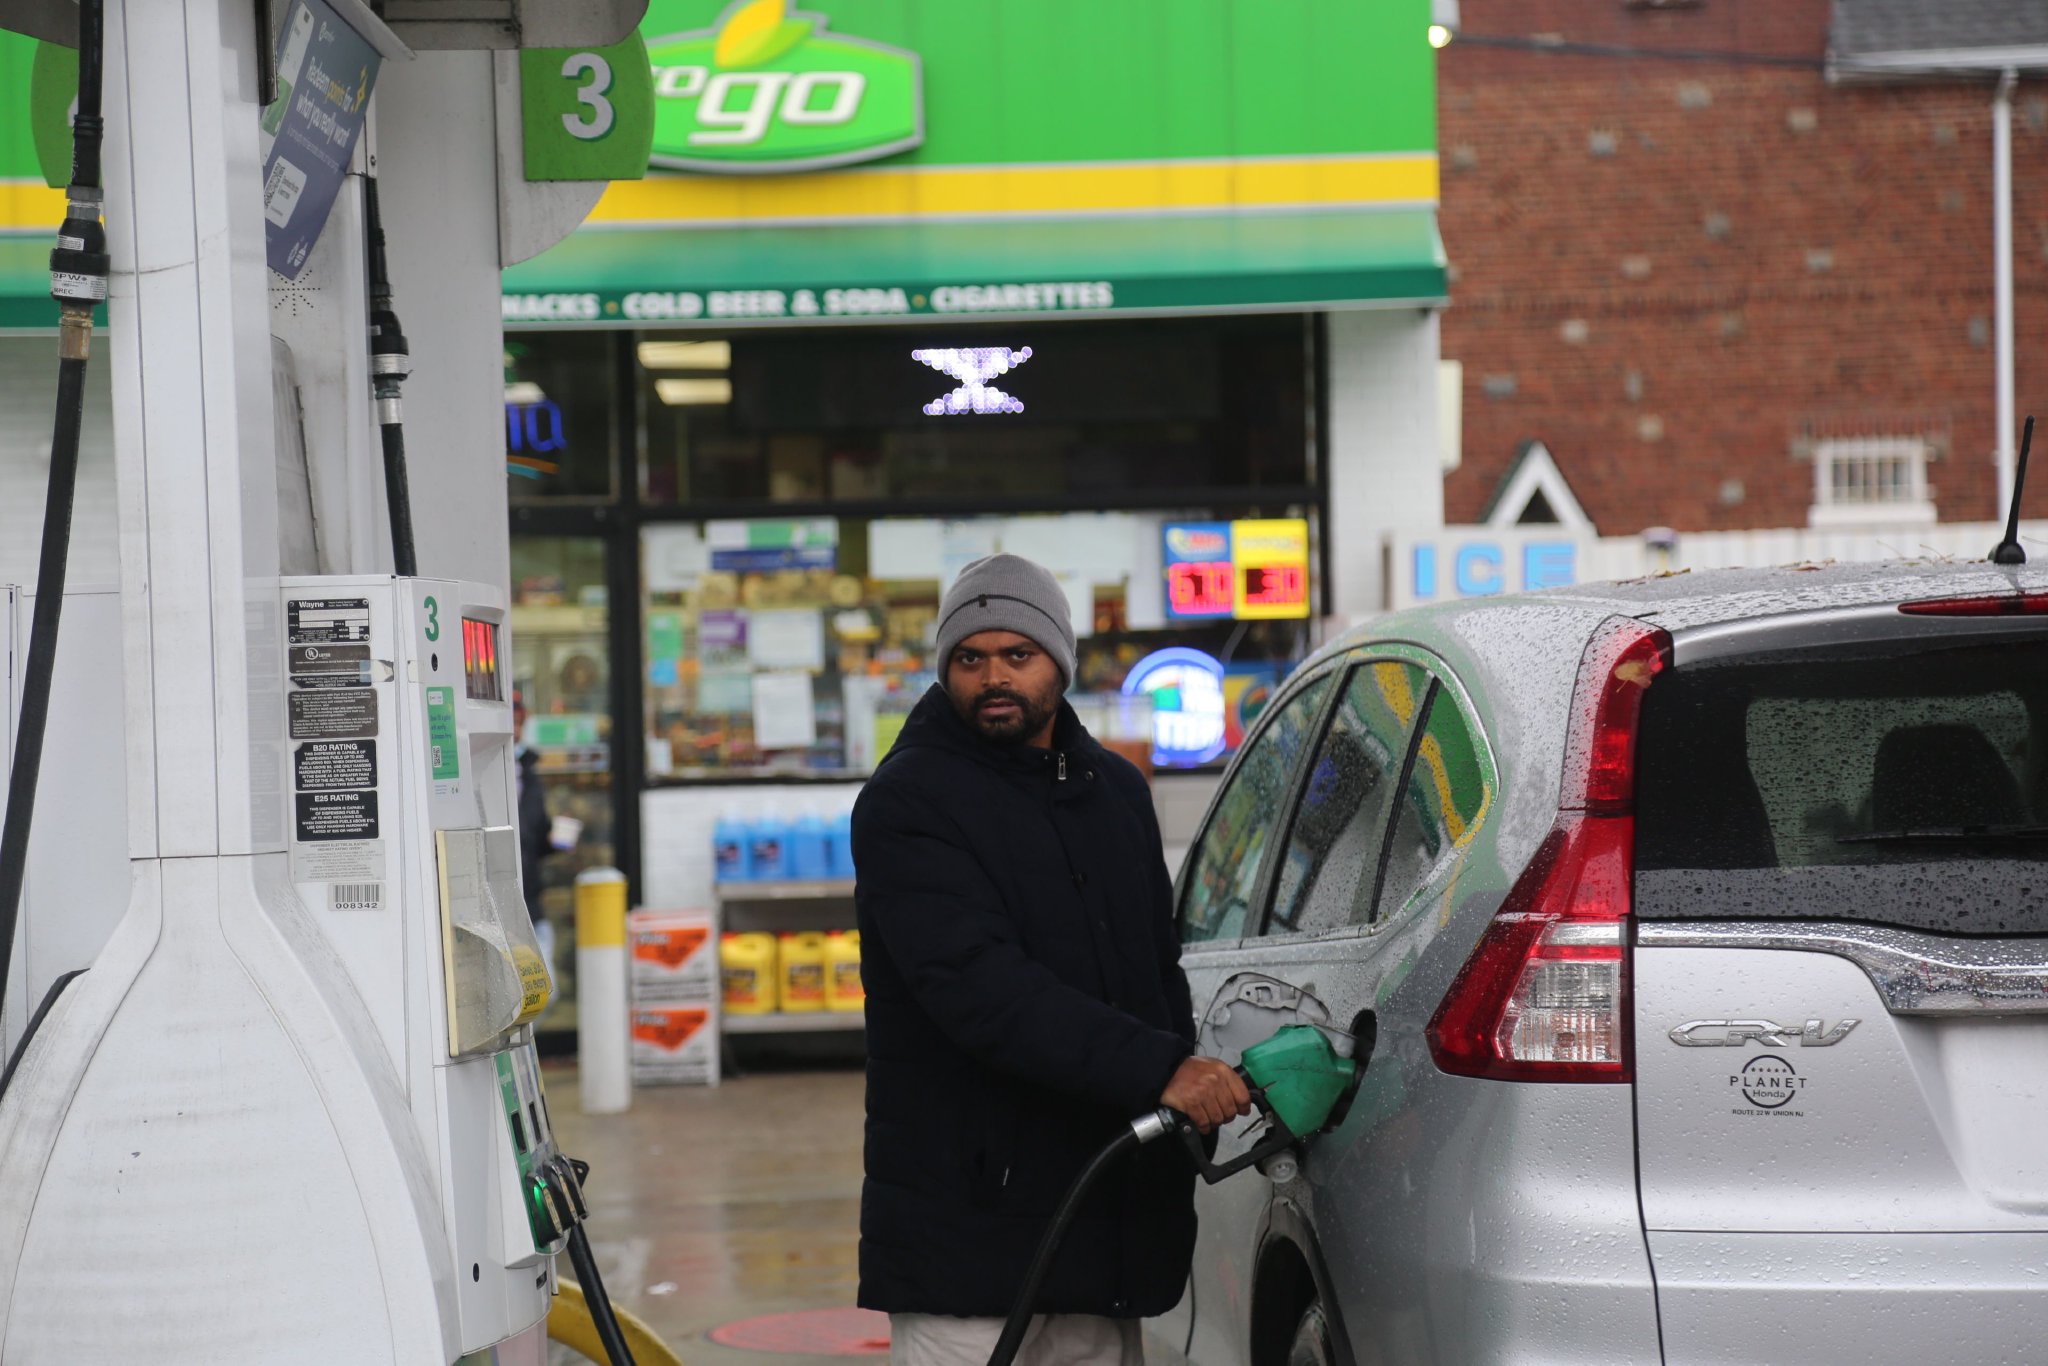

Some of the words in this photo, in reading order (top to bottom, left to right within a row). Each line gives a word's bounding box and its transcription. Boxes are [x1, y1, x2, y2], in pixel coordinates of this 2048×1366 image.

[306, 56, 330, 94] Redeem
[326, 80, 346, 107] points
[562, 52, 615, 141] 3
[296, 90, 315, 120] what
[333, 126, 351, 148] want
[688, 71, 866, 144] go
[502, 293, 599, 320] NACKS
[622, 292, 704, 320] COLD
[706, 290, 786, 318] BEER
[792, 289, 819, 316] &
[823, 287, 910, 315] SODA
[930, 280, 1114, 313] CIGARETTES
[1413, 542, 1575, 598] ICE
[424, 596, 439, 642] 3
[524, 994, 540, 1010] gallon
[1669, 1019, 1862, 1048] CR-V
[1730, 1076, 1807, 1088] PLANET
